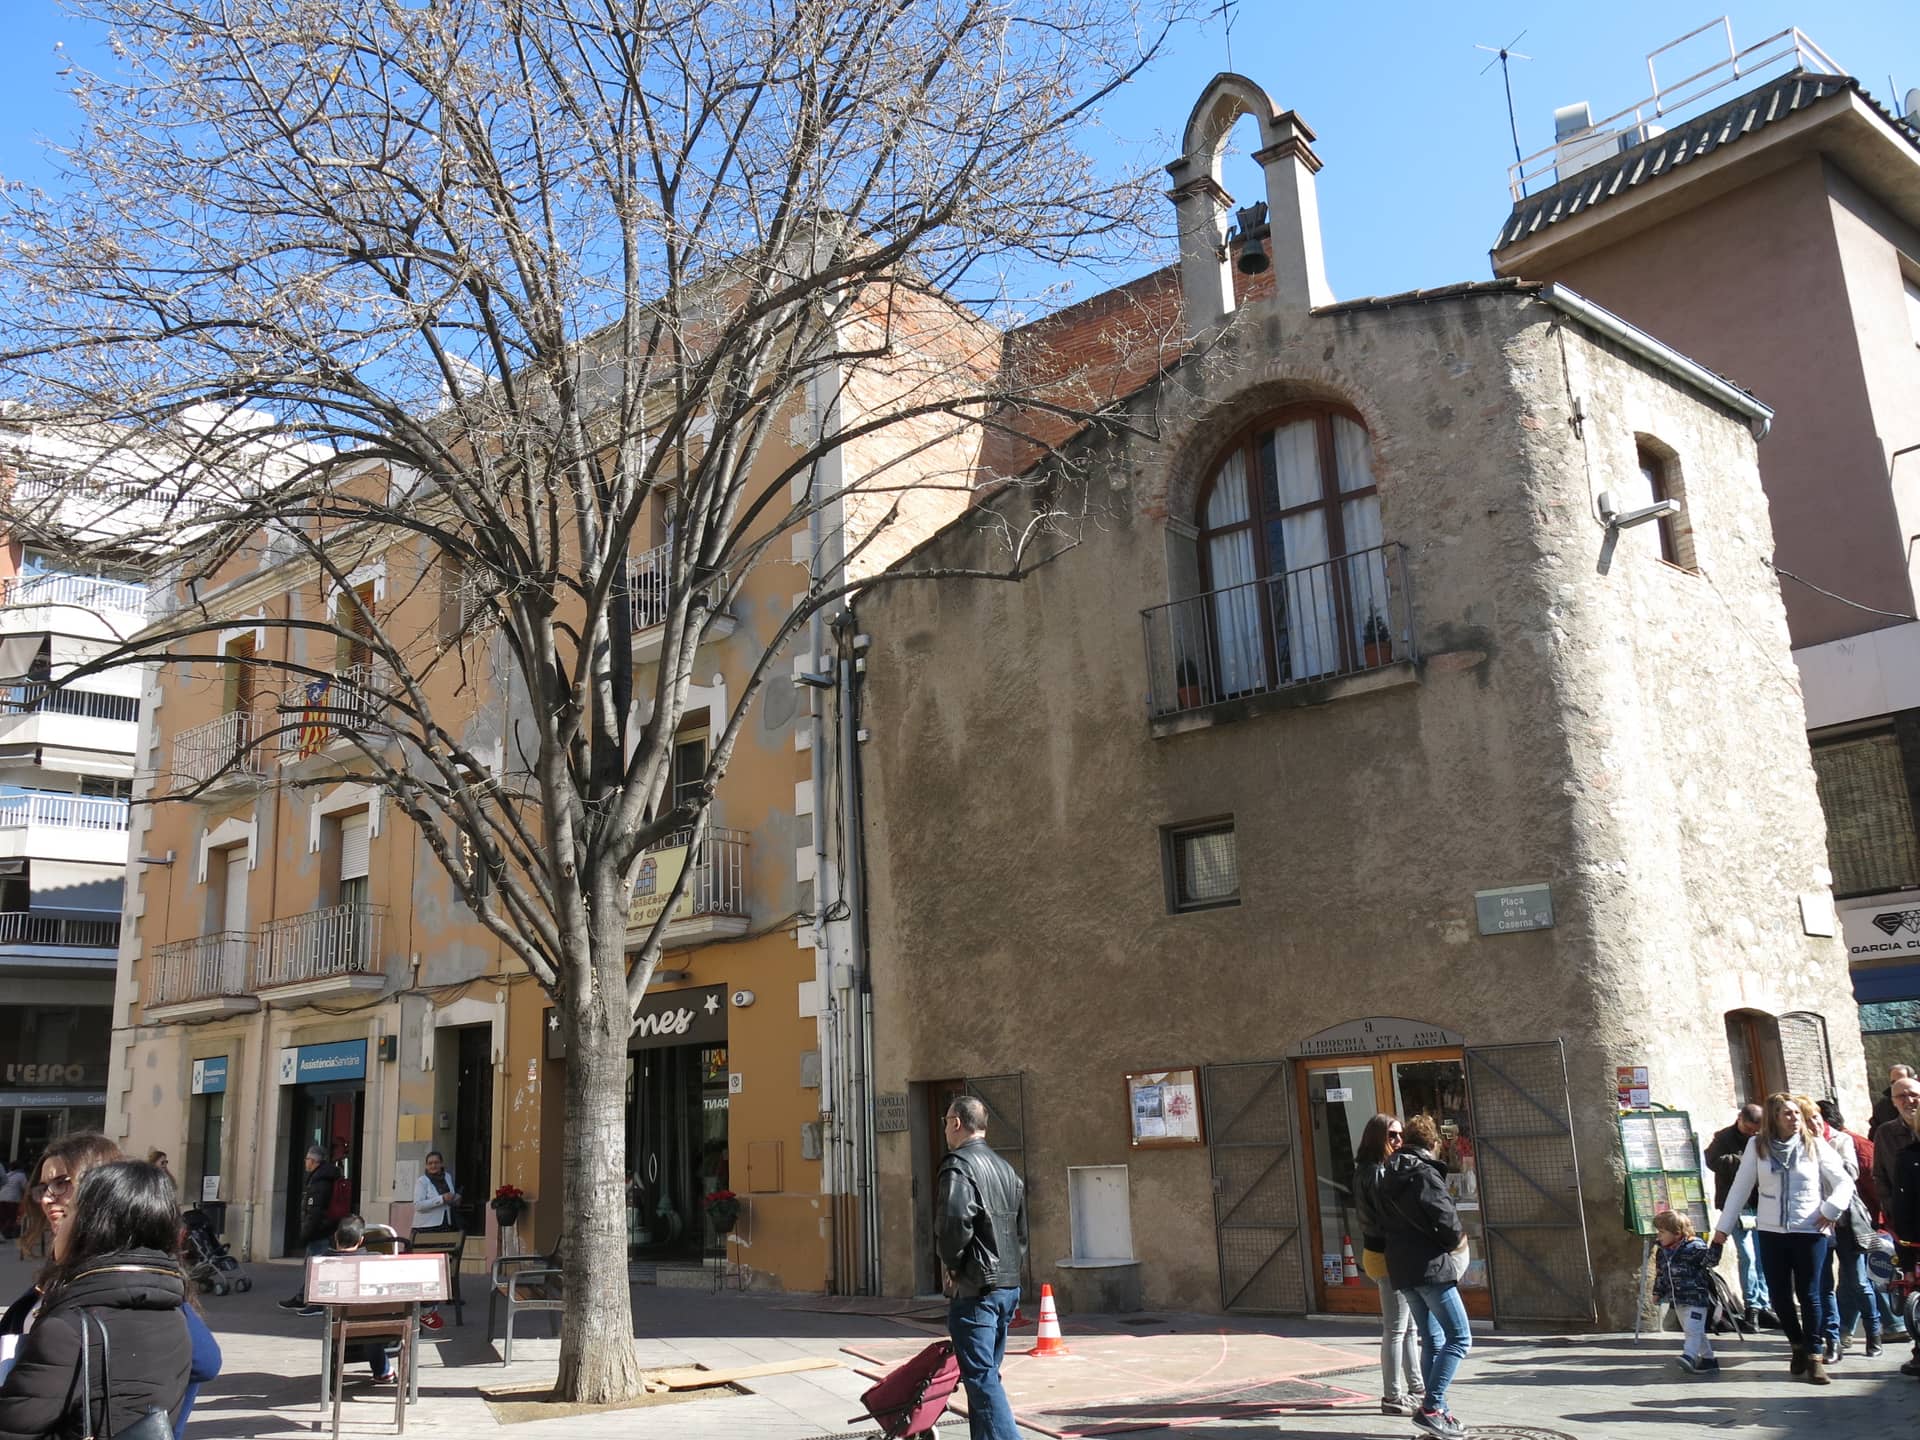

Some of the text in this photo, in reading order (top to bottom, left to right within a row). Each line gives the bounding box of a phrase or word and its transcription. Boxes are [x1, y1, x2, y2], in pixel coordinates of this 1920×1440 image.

[1503, 907, 1527, 917] de la
[1851, 942, 1902, 954] GARCIA
[1412, 1031, 1449, 1047] ANNA
[879, 1119, 905, 1130] ANNA
